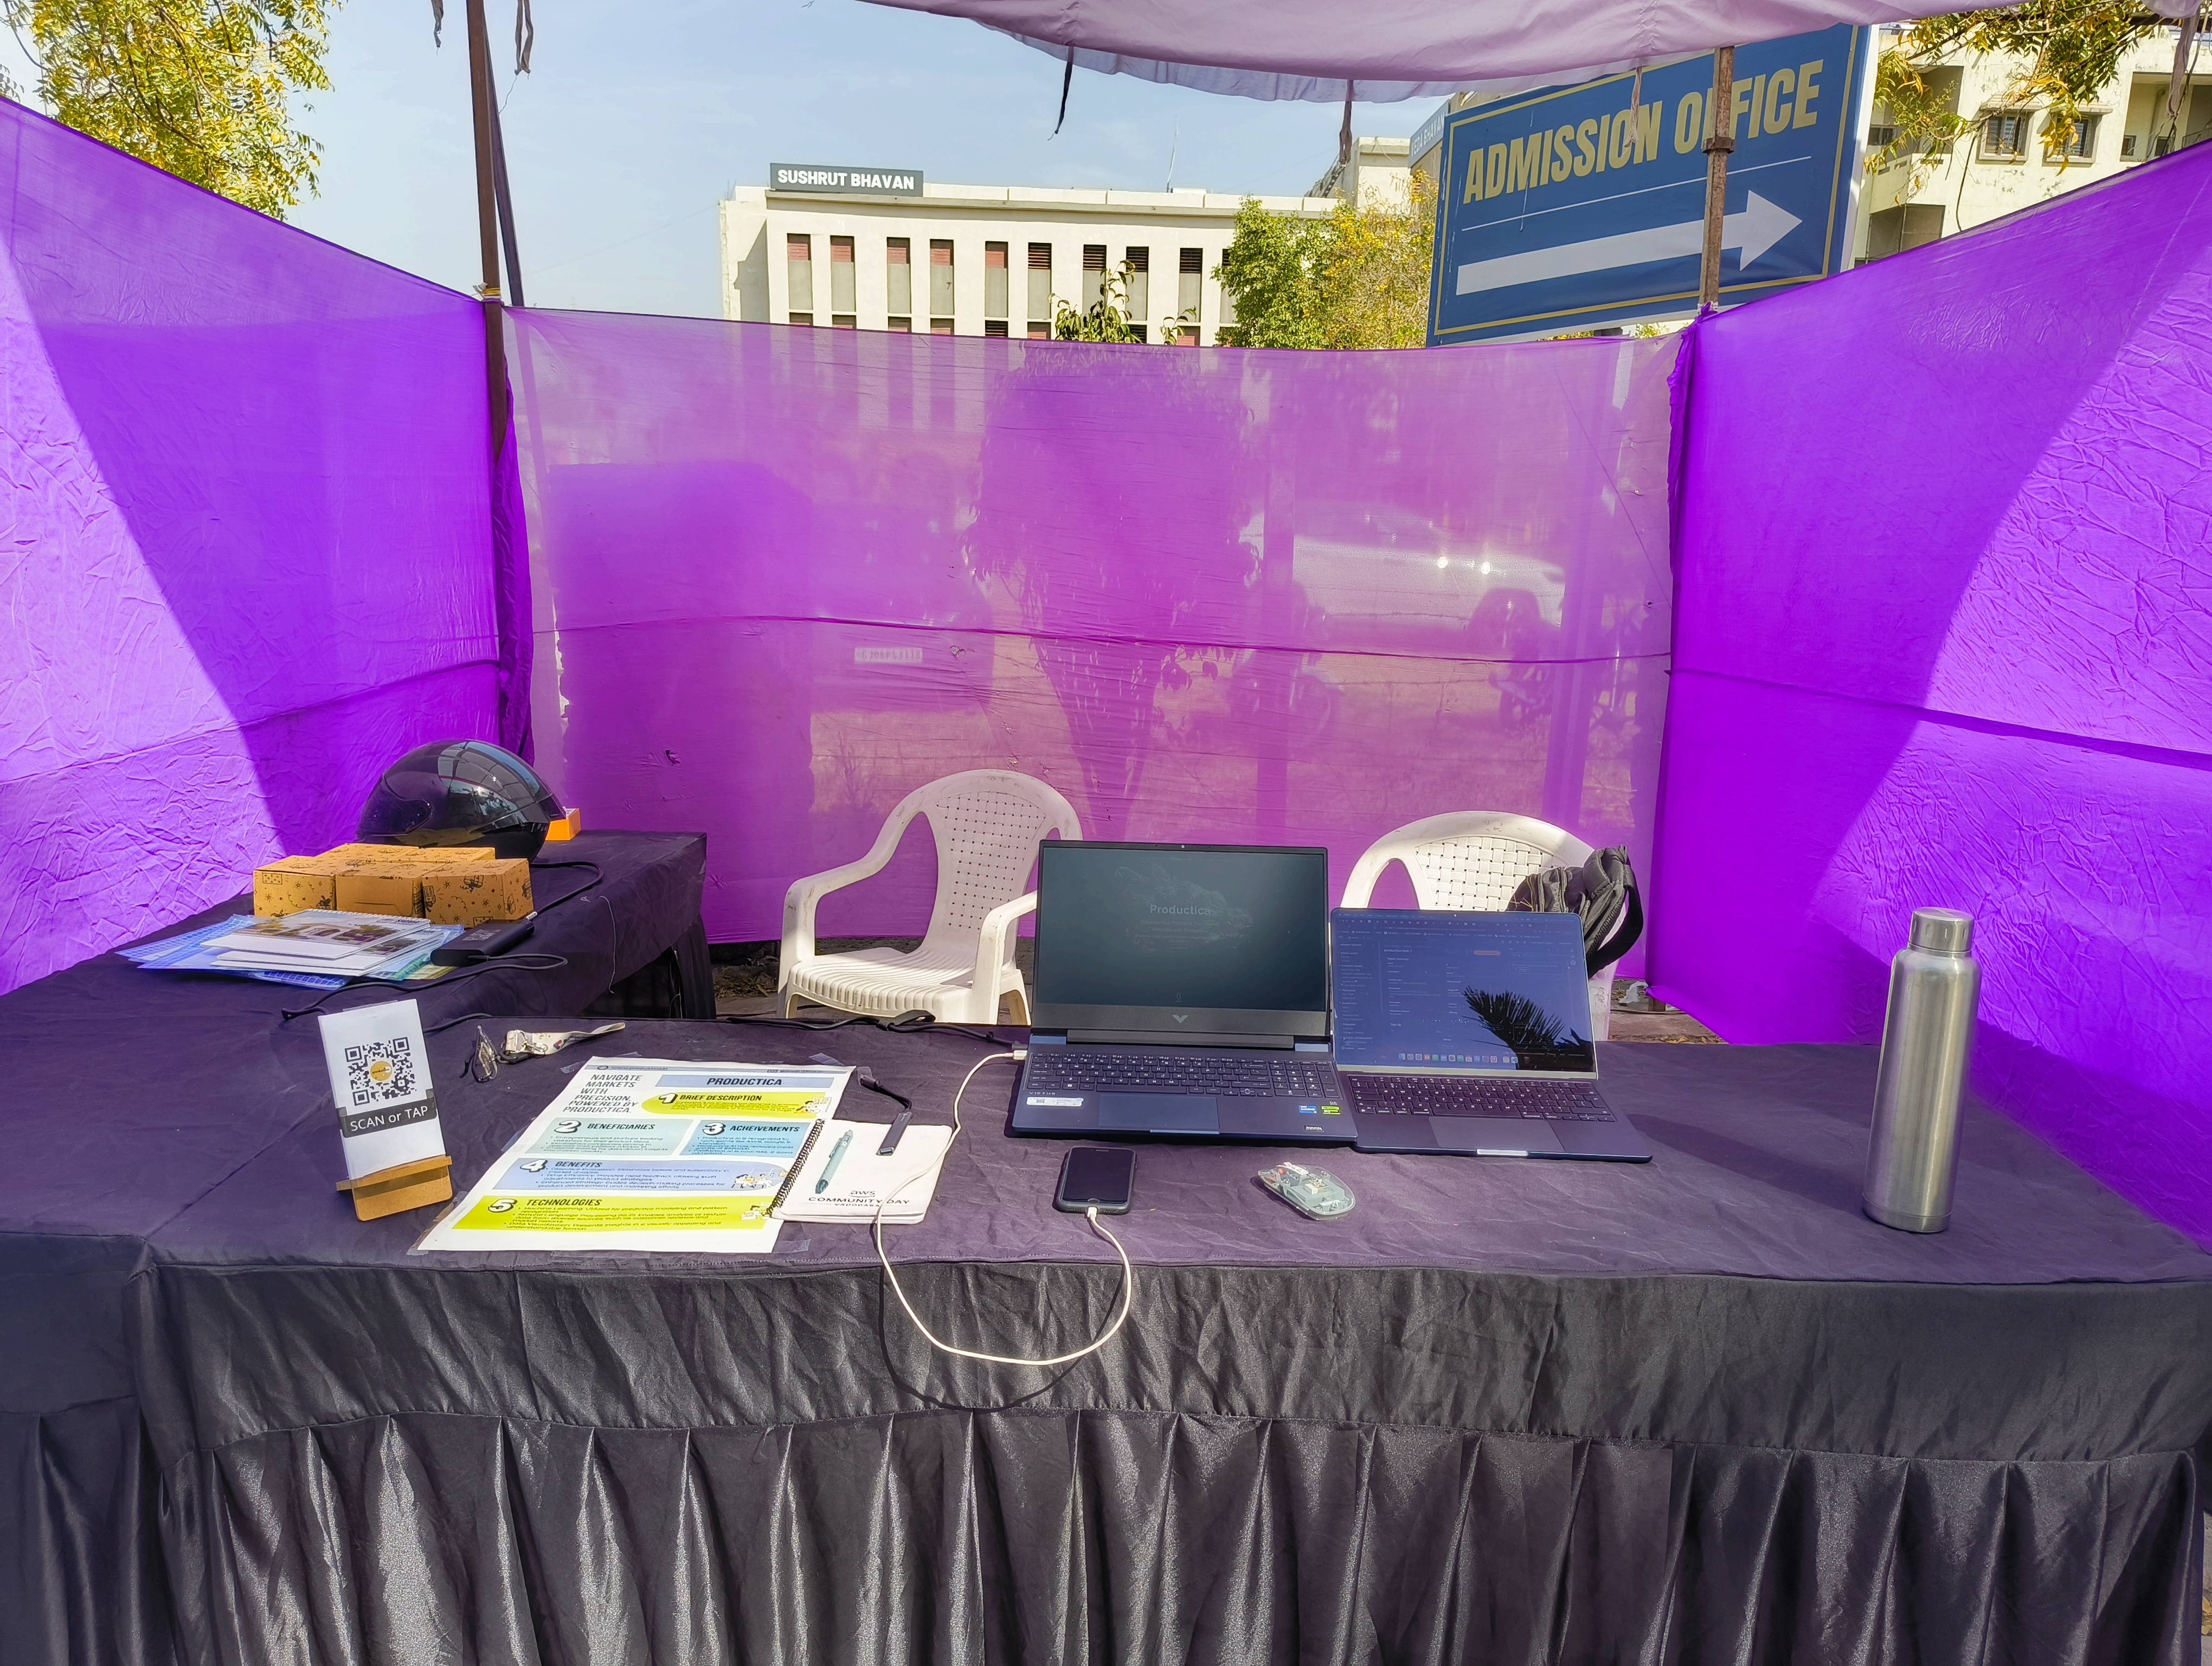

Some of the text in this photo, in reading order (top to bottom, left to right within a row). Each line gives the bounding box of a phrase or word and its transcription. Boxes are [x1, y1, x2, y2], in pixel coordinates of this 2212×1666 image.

[1463, 100, 1663, 204] ADMISSION
[778, 169, 914, 190] SUSHRUT BHAVAN
[1150, 905, 1211, 915] Productica
[706, 1078, 782, 1086] PRODUCTICA
[350, 1106, 428, 1131] SCAN or TAP
[554, 1120, 582, 1133] 2
[702, 1123, 726, 1136] 3
[520, 1159, 548, 1172] 4
[487, 1199, 518, 1213] 5
